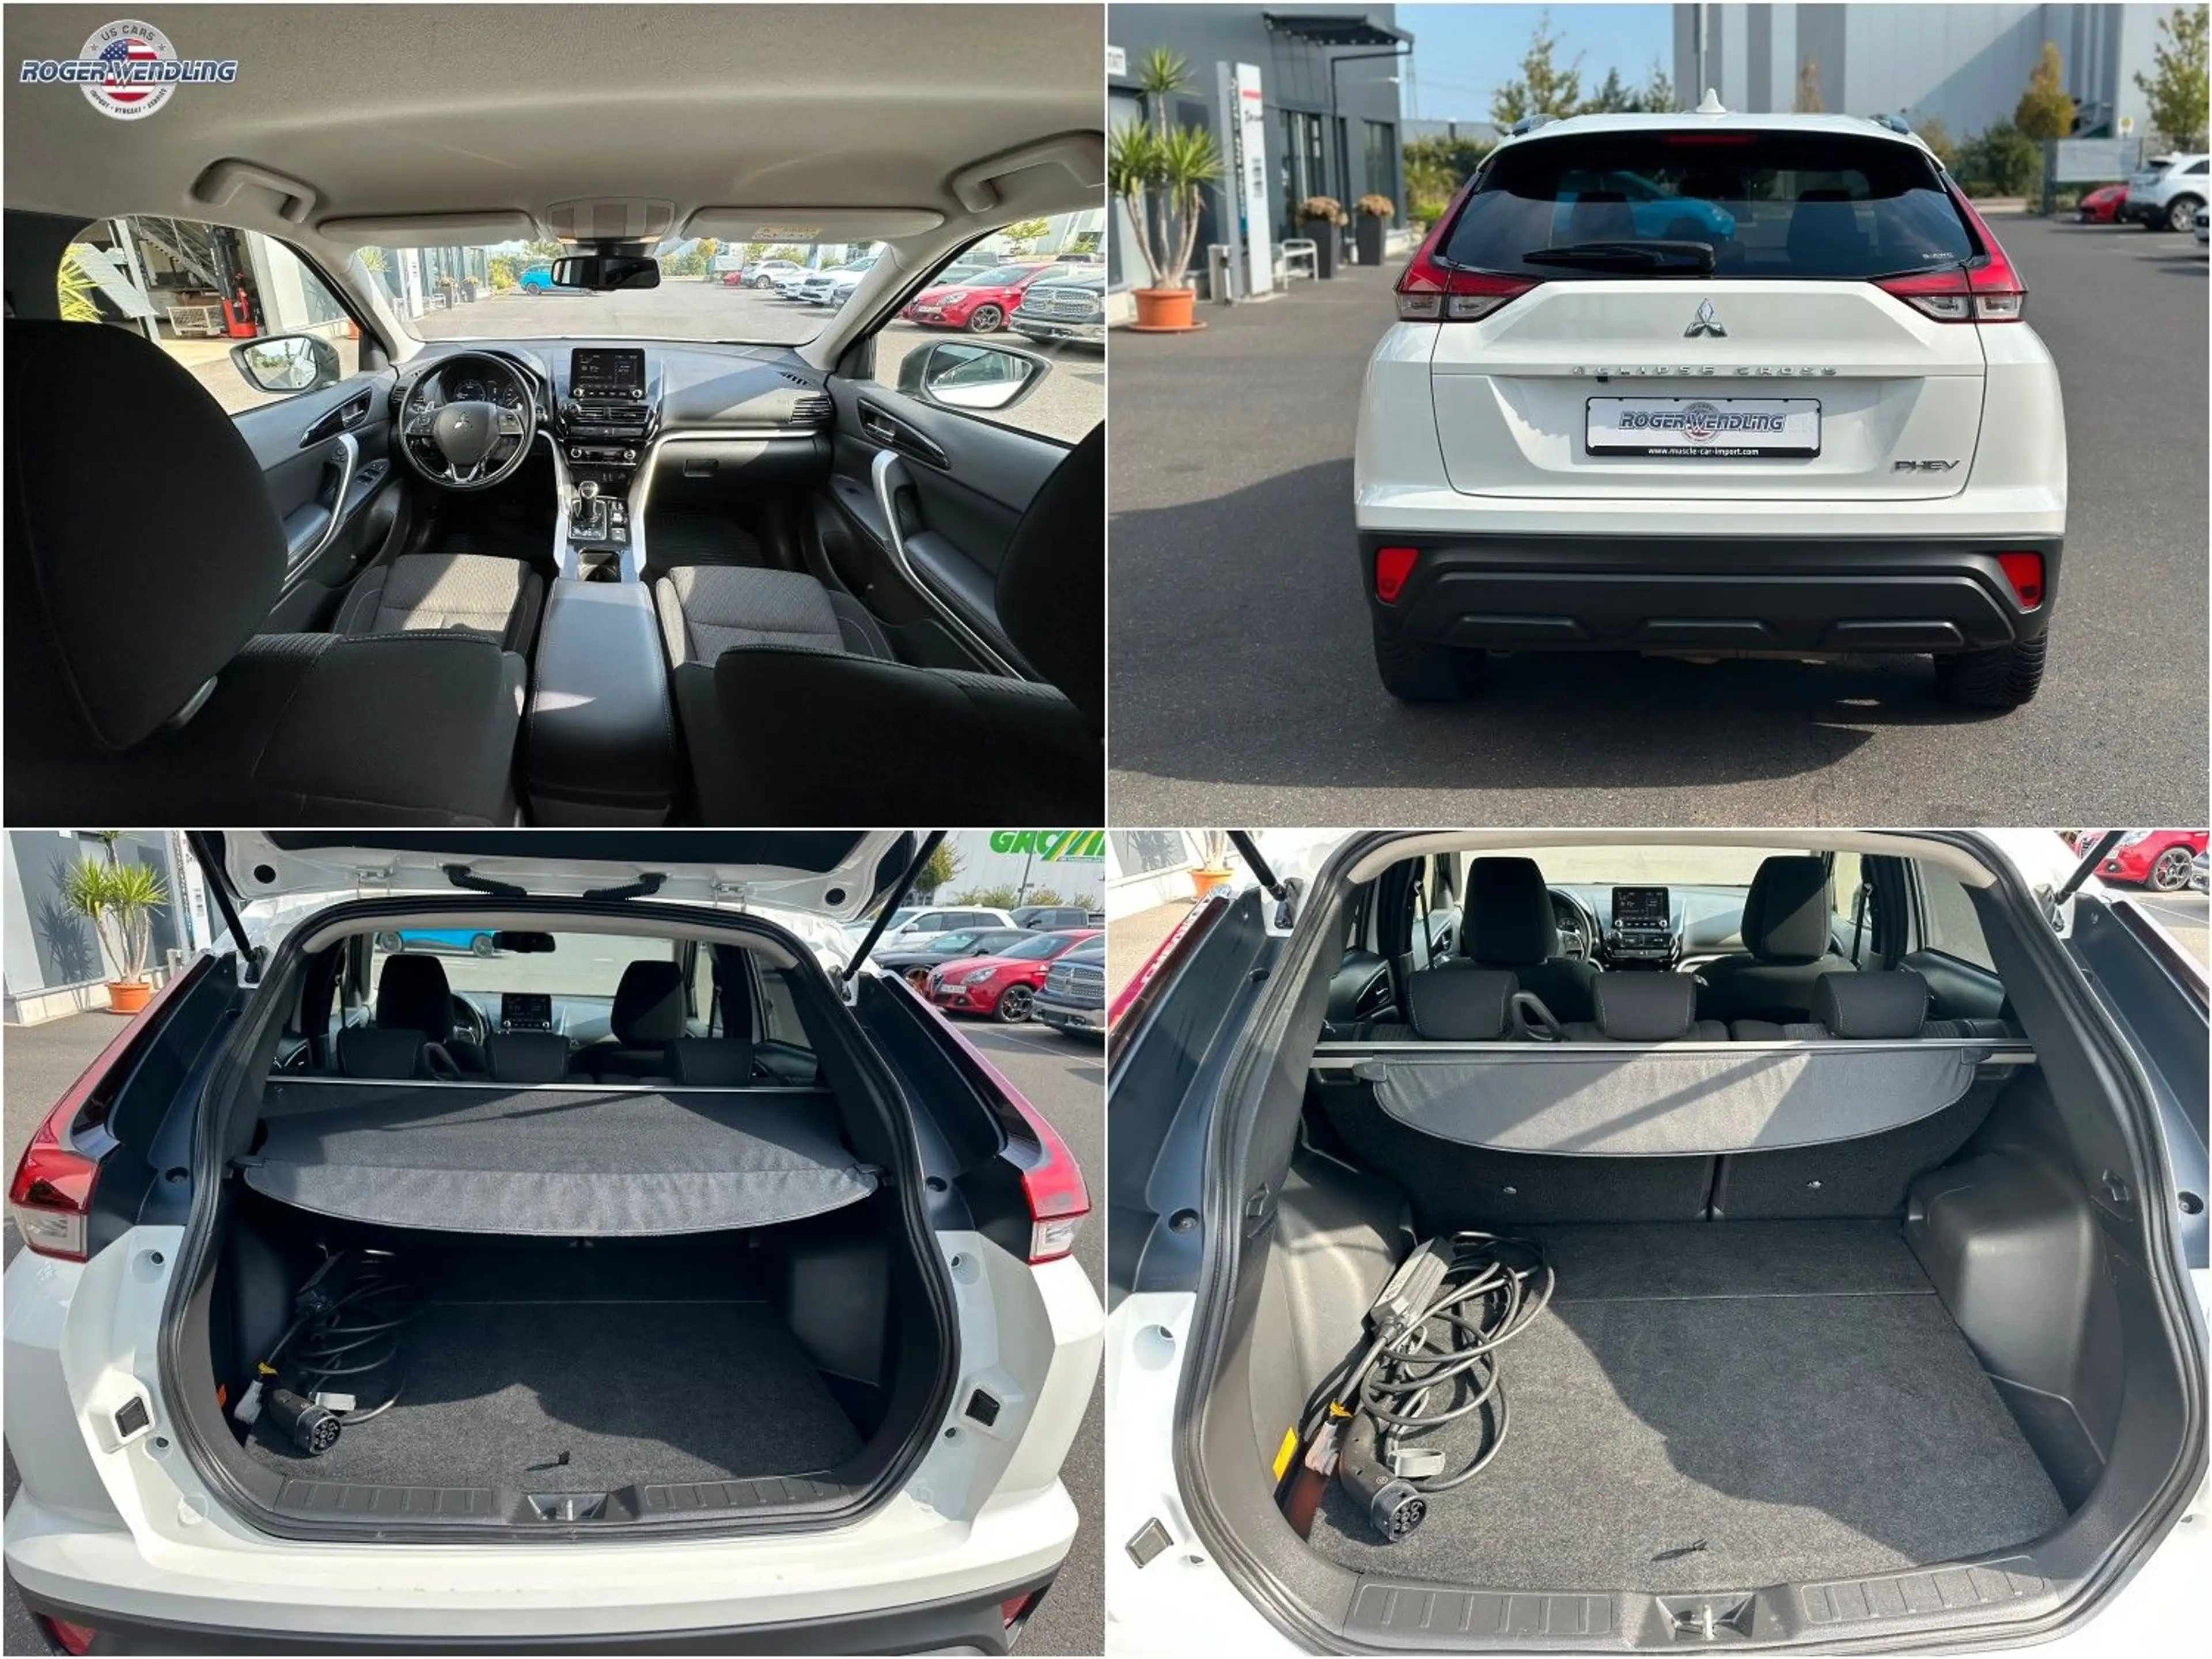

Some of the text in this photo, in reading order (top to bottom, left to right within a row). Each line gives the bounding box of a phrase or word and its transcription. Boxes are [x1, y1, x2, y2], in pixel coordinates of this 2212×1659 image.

[1736, 366, 1837, 376] CROSS
[1619, 411, 1787, 432] ROGER WENDLING
[1648, 447, 1759, 456] www.muscle-car-import.com
[1894, 460, 1960, 471] PHEV
